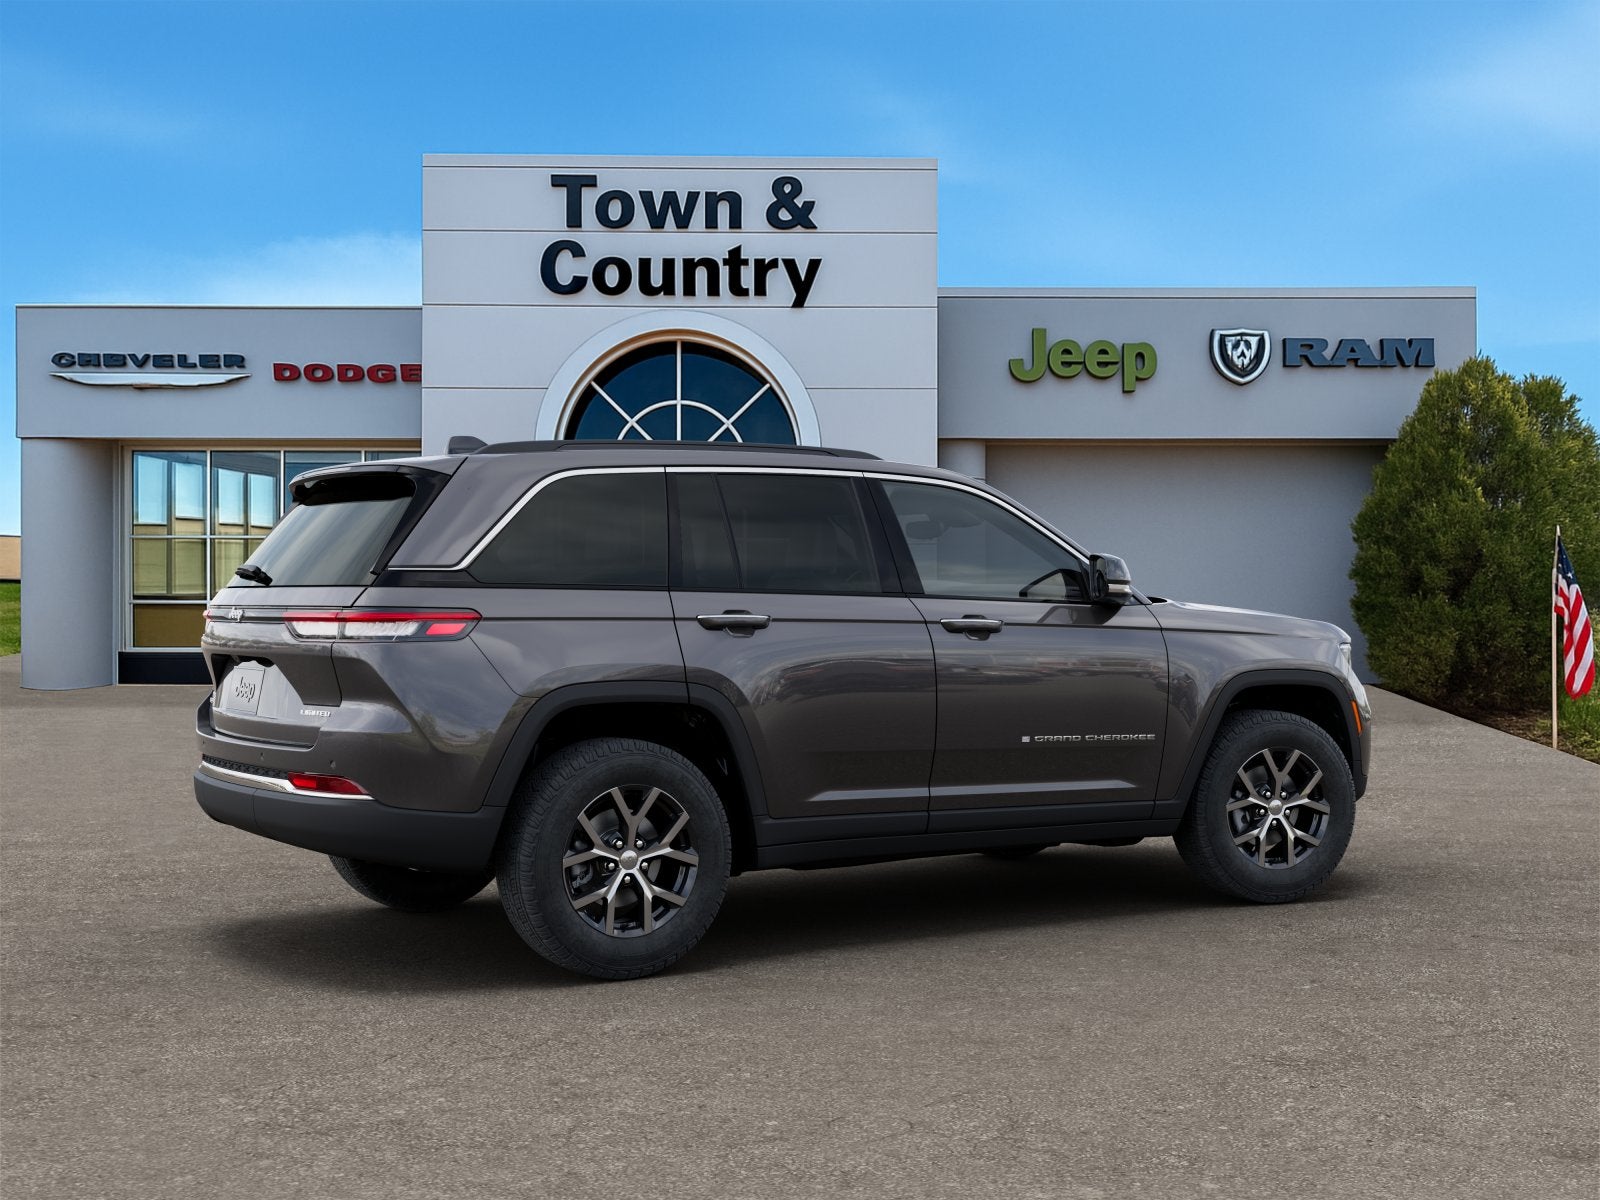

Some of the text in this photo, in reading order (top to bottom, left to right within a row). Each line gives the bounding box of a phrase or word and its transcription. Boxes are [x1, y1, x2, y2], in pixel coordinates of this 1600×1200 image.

[550, 174, 818, 230] Town &
[540, 239, 823, 308] Country
[272, 362, 422, 383] DODGE
[1008, 327, 1158, 393] Jeep
[1282, 337, 1436, 368] RAM
